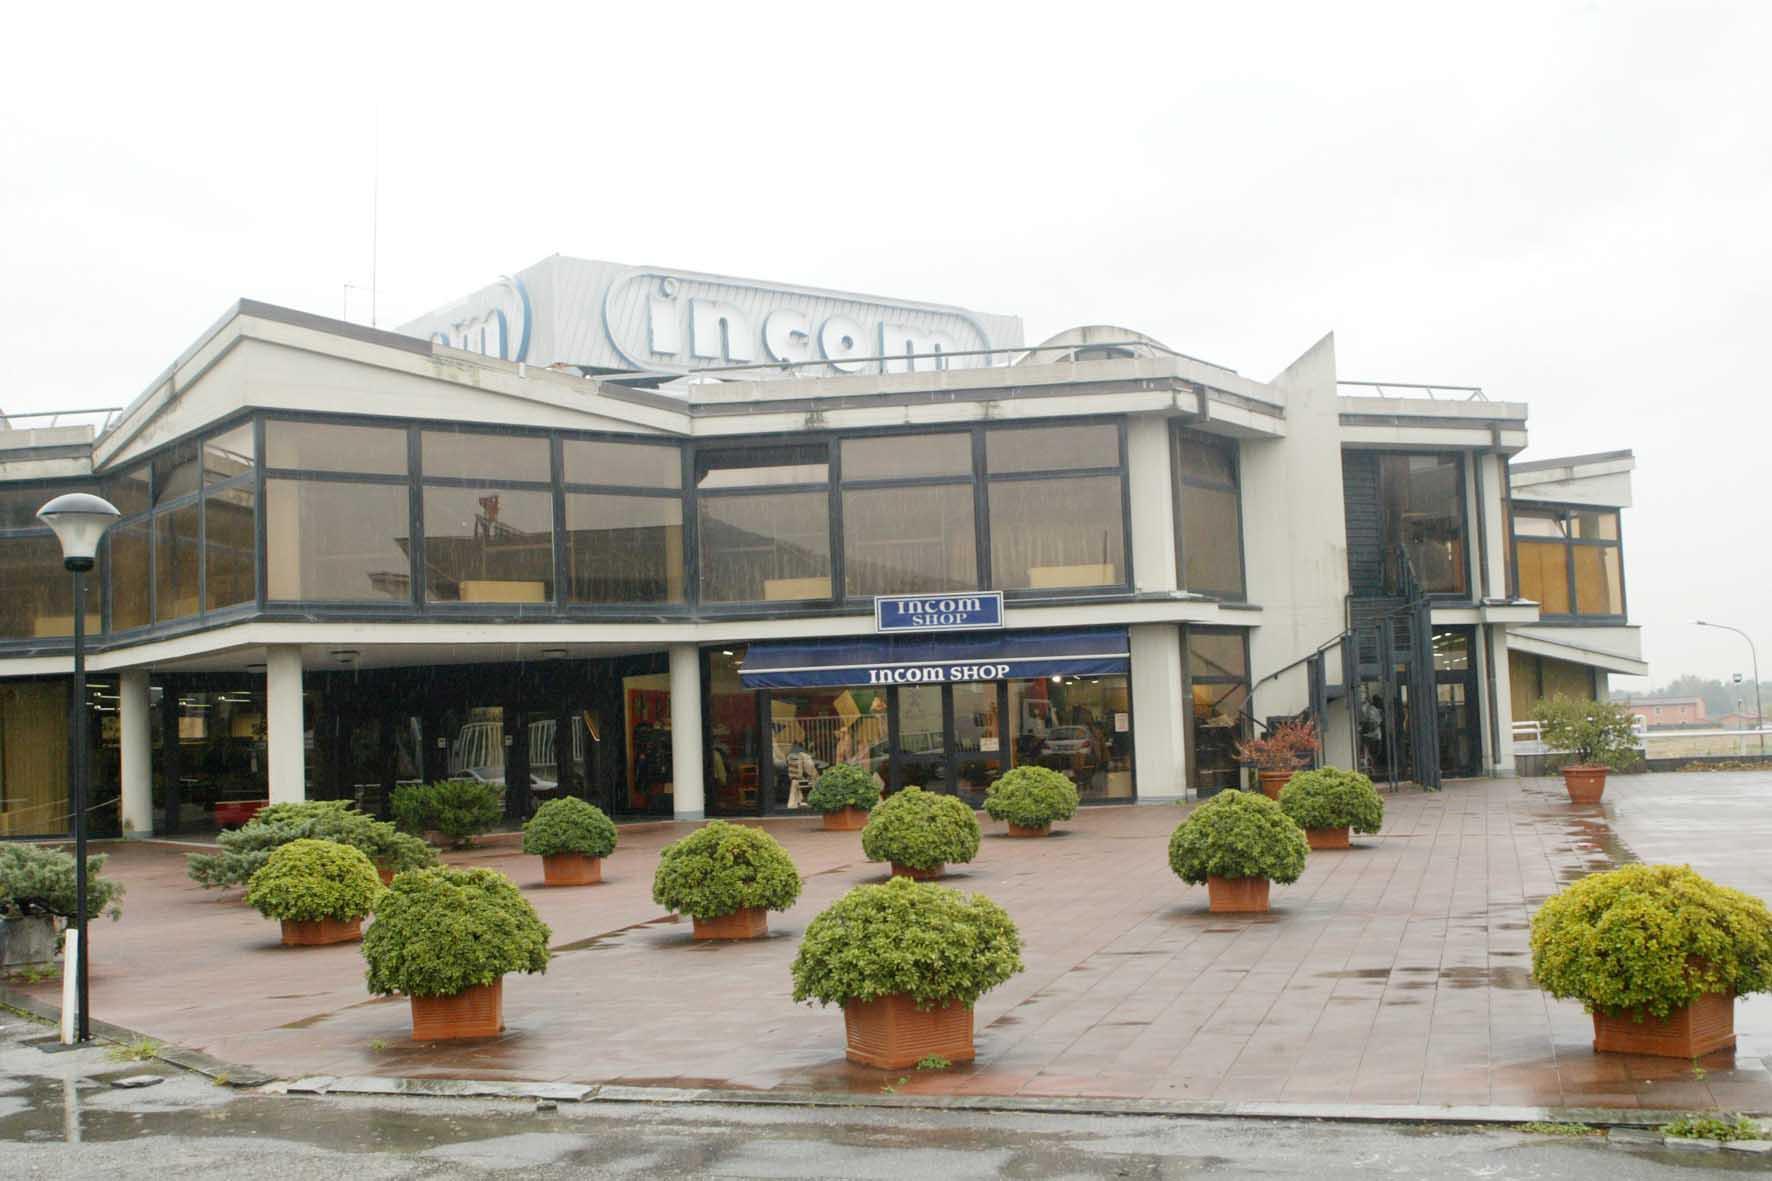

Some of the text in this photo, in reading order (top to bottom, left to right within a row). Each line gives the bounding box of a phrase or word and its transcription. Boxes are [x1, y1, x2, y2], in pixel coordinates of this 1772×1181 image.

[646, 277, 958, 375] incom
[912, 613, 967, 626] SHOP
[950, 664, 1010, 680] SHOP
